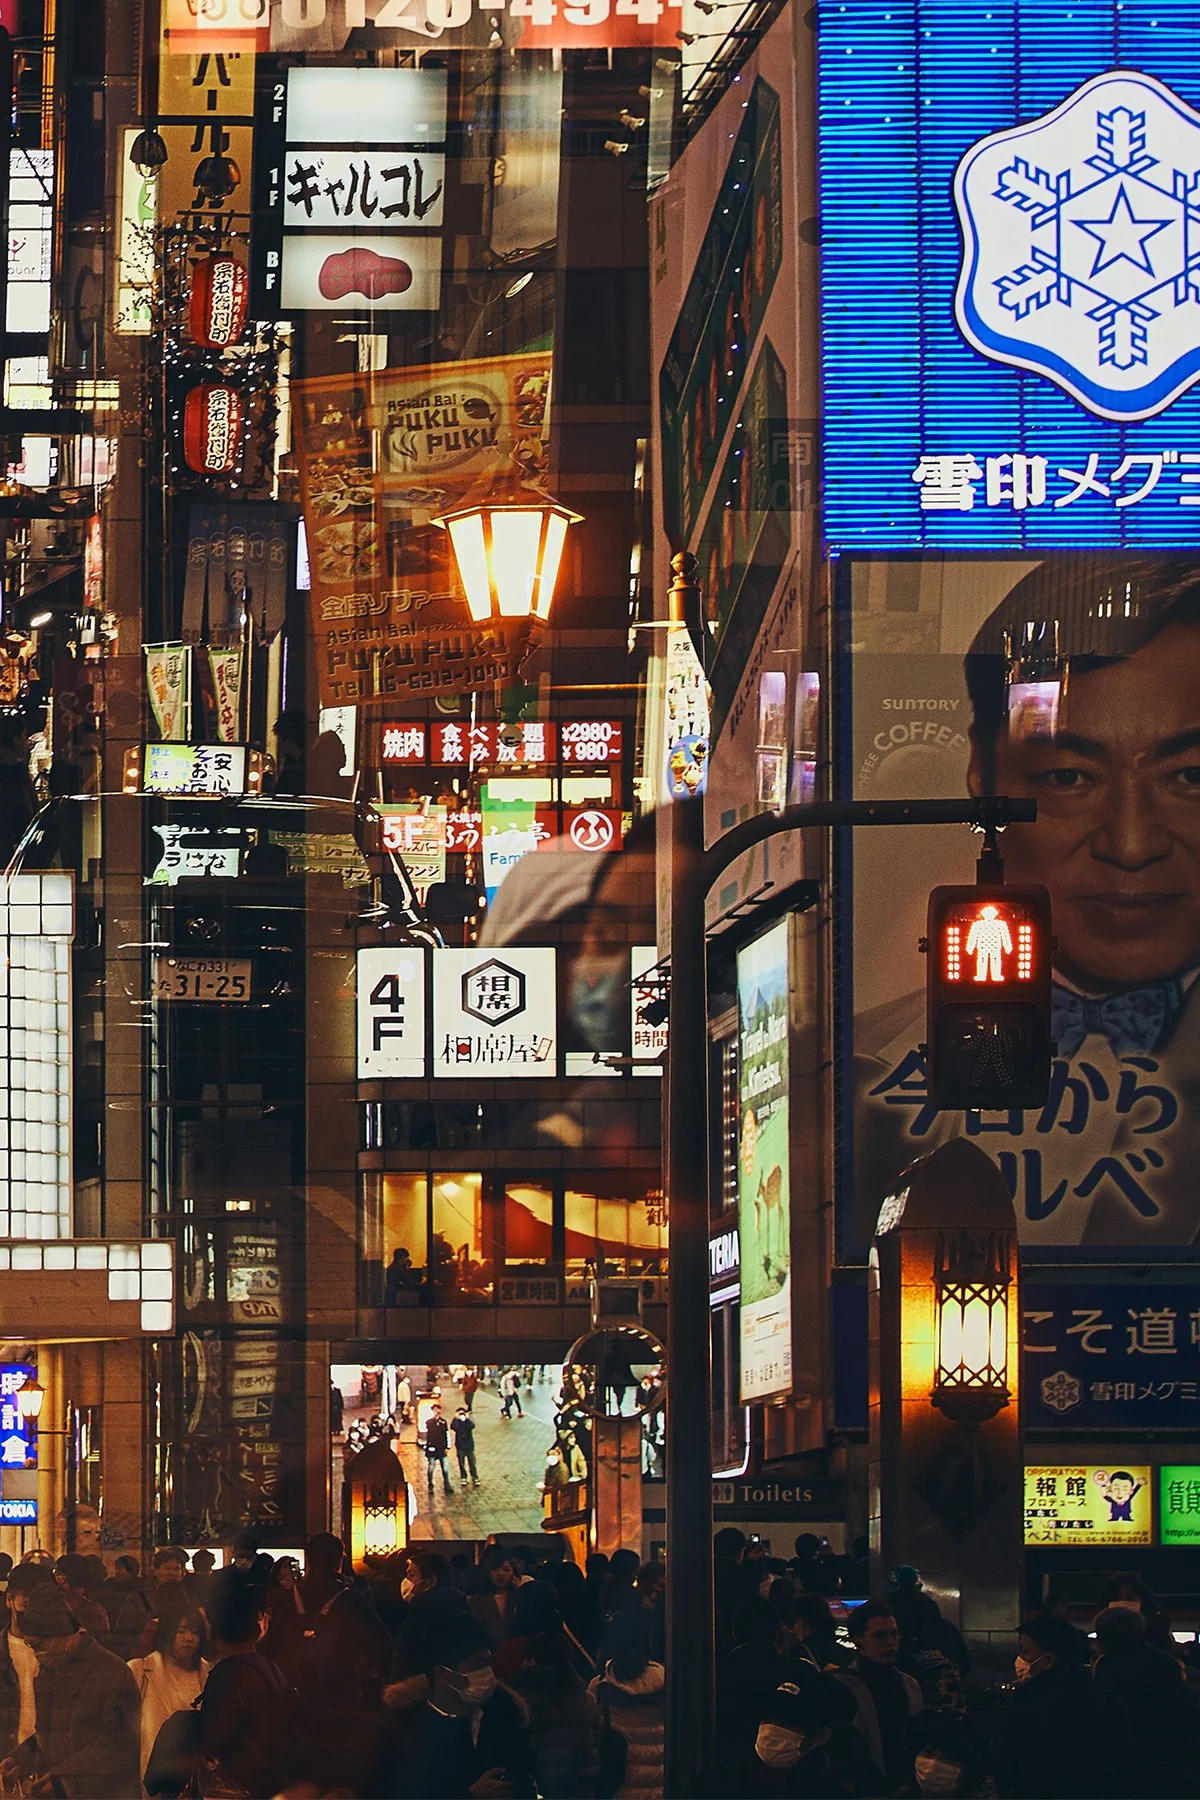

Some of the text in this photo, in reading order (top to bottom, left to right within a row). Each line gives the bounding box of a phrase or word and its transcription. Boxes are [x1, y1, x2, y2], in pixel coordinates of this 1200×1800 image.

[287, 158, 443, 220] ギャルコレ
[383, 728, 425, 759] 焼肉
[383, 816, 425, 849] 5F
[175, 975, 246, 998] 31-25
[475, 975, 511, 1010] 相席
[369, 974, 405, 1051] 4F
[440, 1033, 545, 1064] 相席屋
[742, 1486, 812, 1502] Toilets
[1024, 1477, 1087, 1497] 報館
